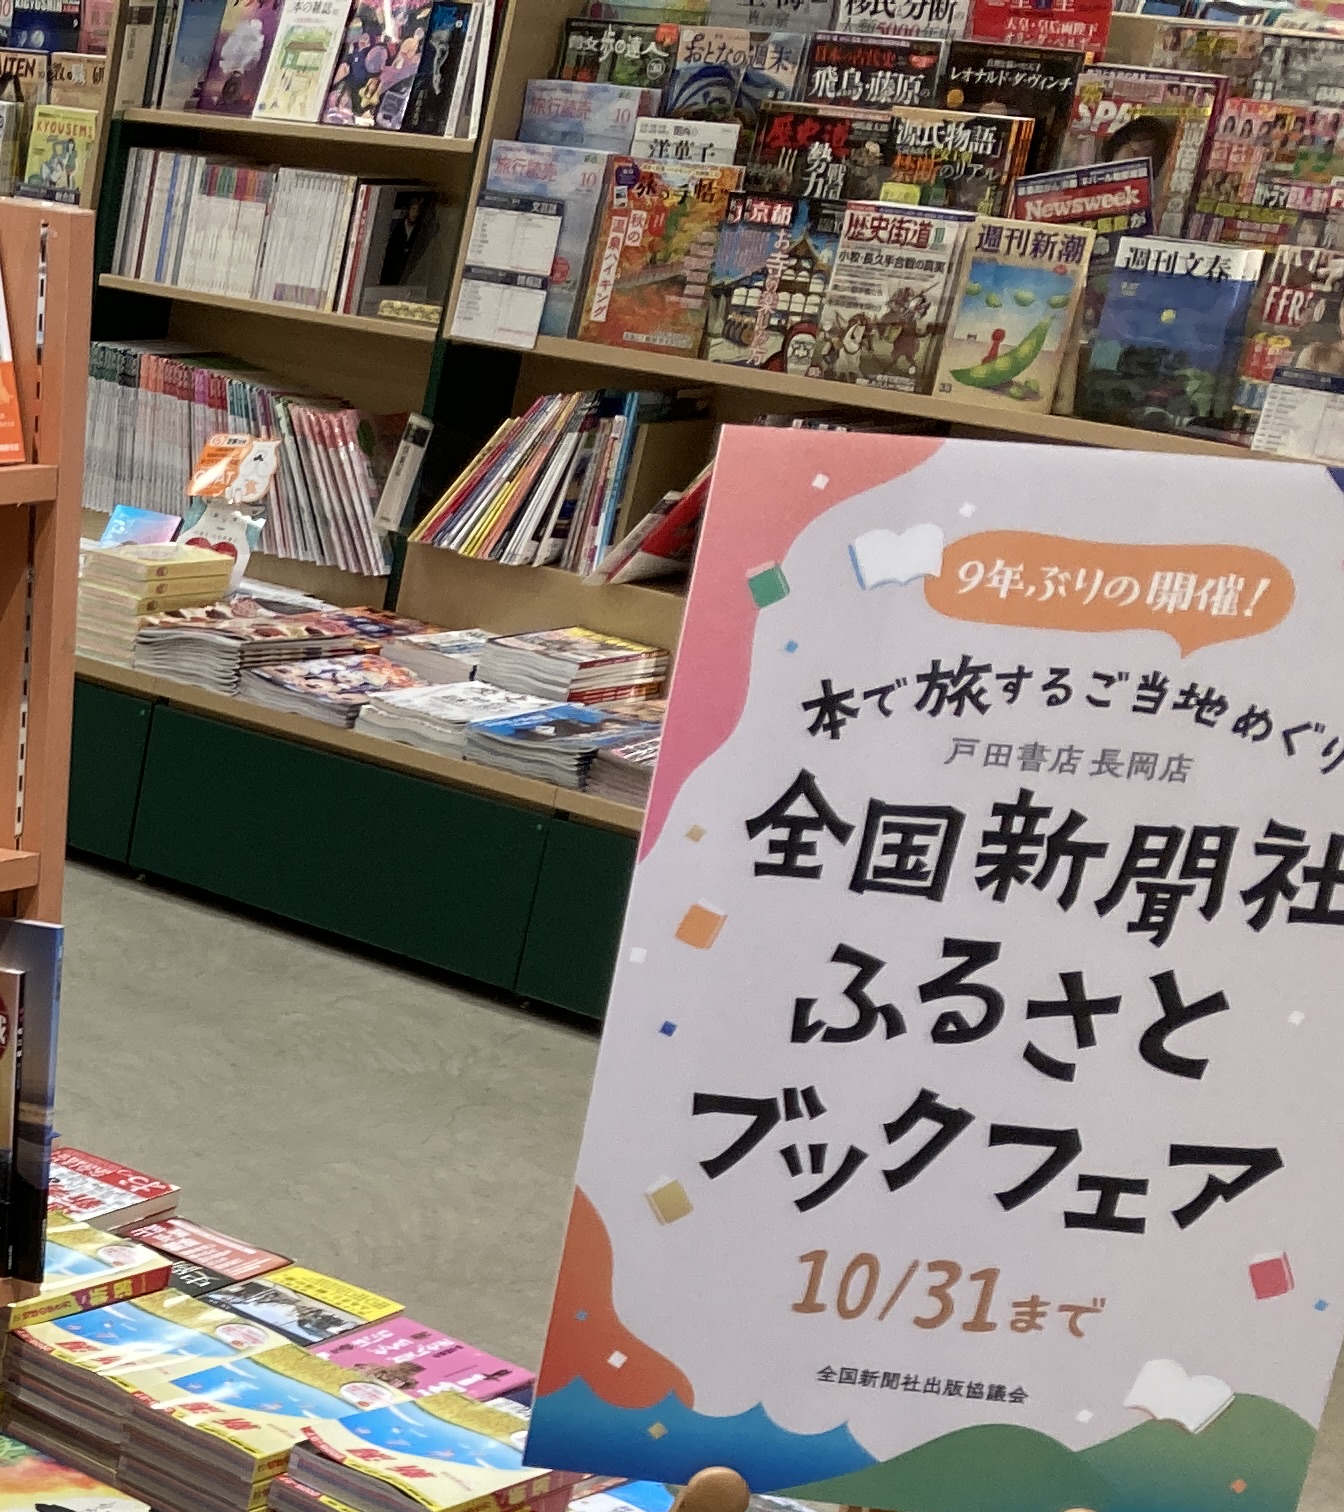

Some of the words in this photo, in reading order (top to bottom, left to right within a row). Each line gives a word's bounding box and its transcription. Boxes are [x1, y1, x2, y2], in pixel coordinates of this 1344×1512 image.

[750, 202, 792, 225] 京都
[1024, 186, 1141, 221] Newsweek
[846, 212, 934, 249] 歴史街道
[974, 225, 1086, 264] 週刊新潮
[1129, 246, 1232, 283] 週刊文春
[956, 555, 1265, 621] 9年ぶりの開催!
[802, 653, 1344, 774] 本で旅するご当地めぐり
[944, 736, 1082, 778] 戸田書店
[1088, 746, 1196, 786] 長岡店
[744, 767, 1344, 947] 全国新聞社
[790, 938, 1232, 1081] ふるさと
[692, 1086, 1285, 1235] ブックフェア
[790, 1248, 1107, 1339] 10/31まで
[817, 1364, 1030, 1405] 全国新聞社出版協議会
